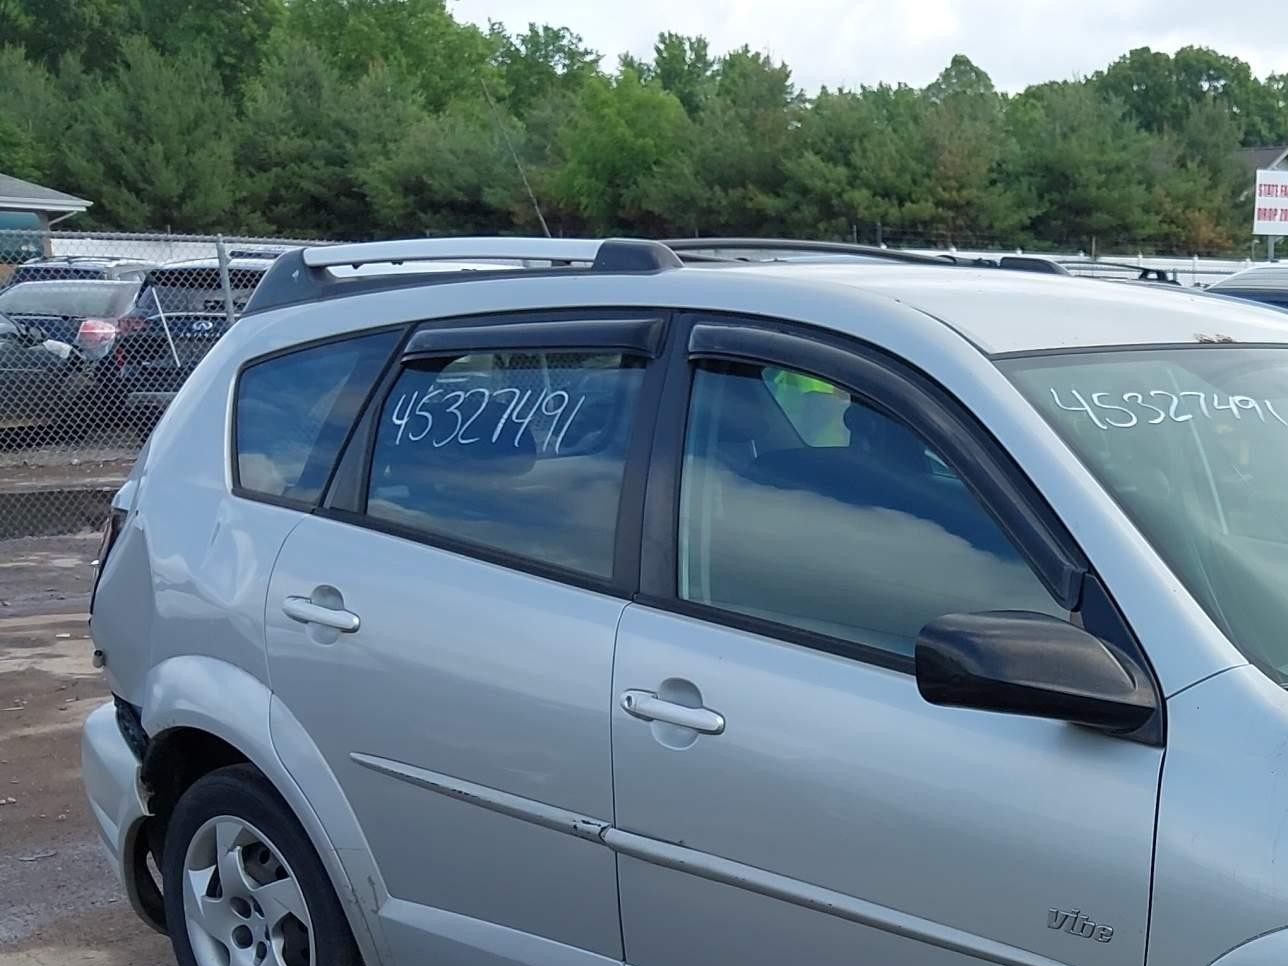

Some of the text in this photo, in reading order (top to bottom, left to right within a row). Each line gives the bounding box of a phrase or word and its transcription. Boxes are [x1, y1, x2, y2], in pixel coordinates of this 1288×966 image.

[1259, 183, 1278, 198] STATE
[1257, 207, 1277, 221] DROP
[392, 388, 586, 455] 45327491
[1050, 387, 1288, 430] 45327491
